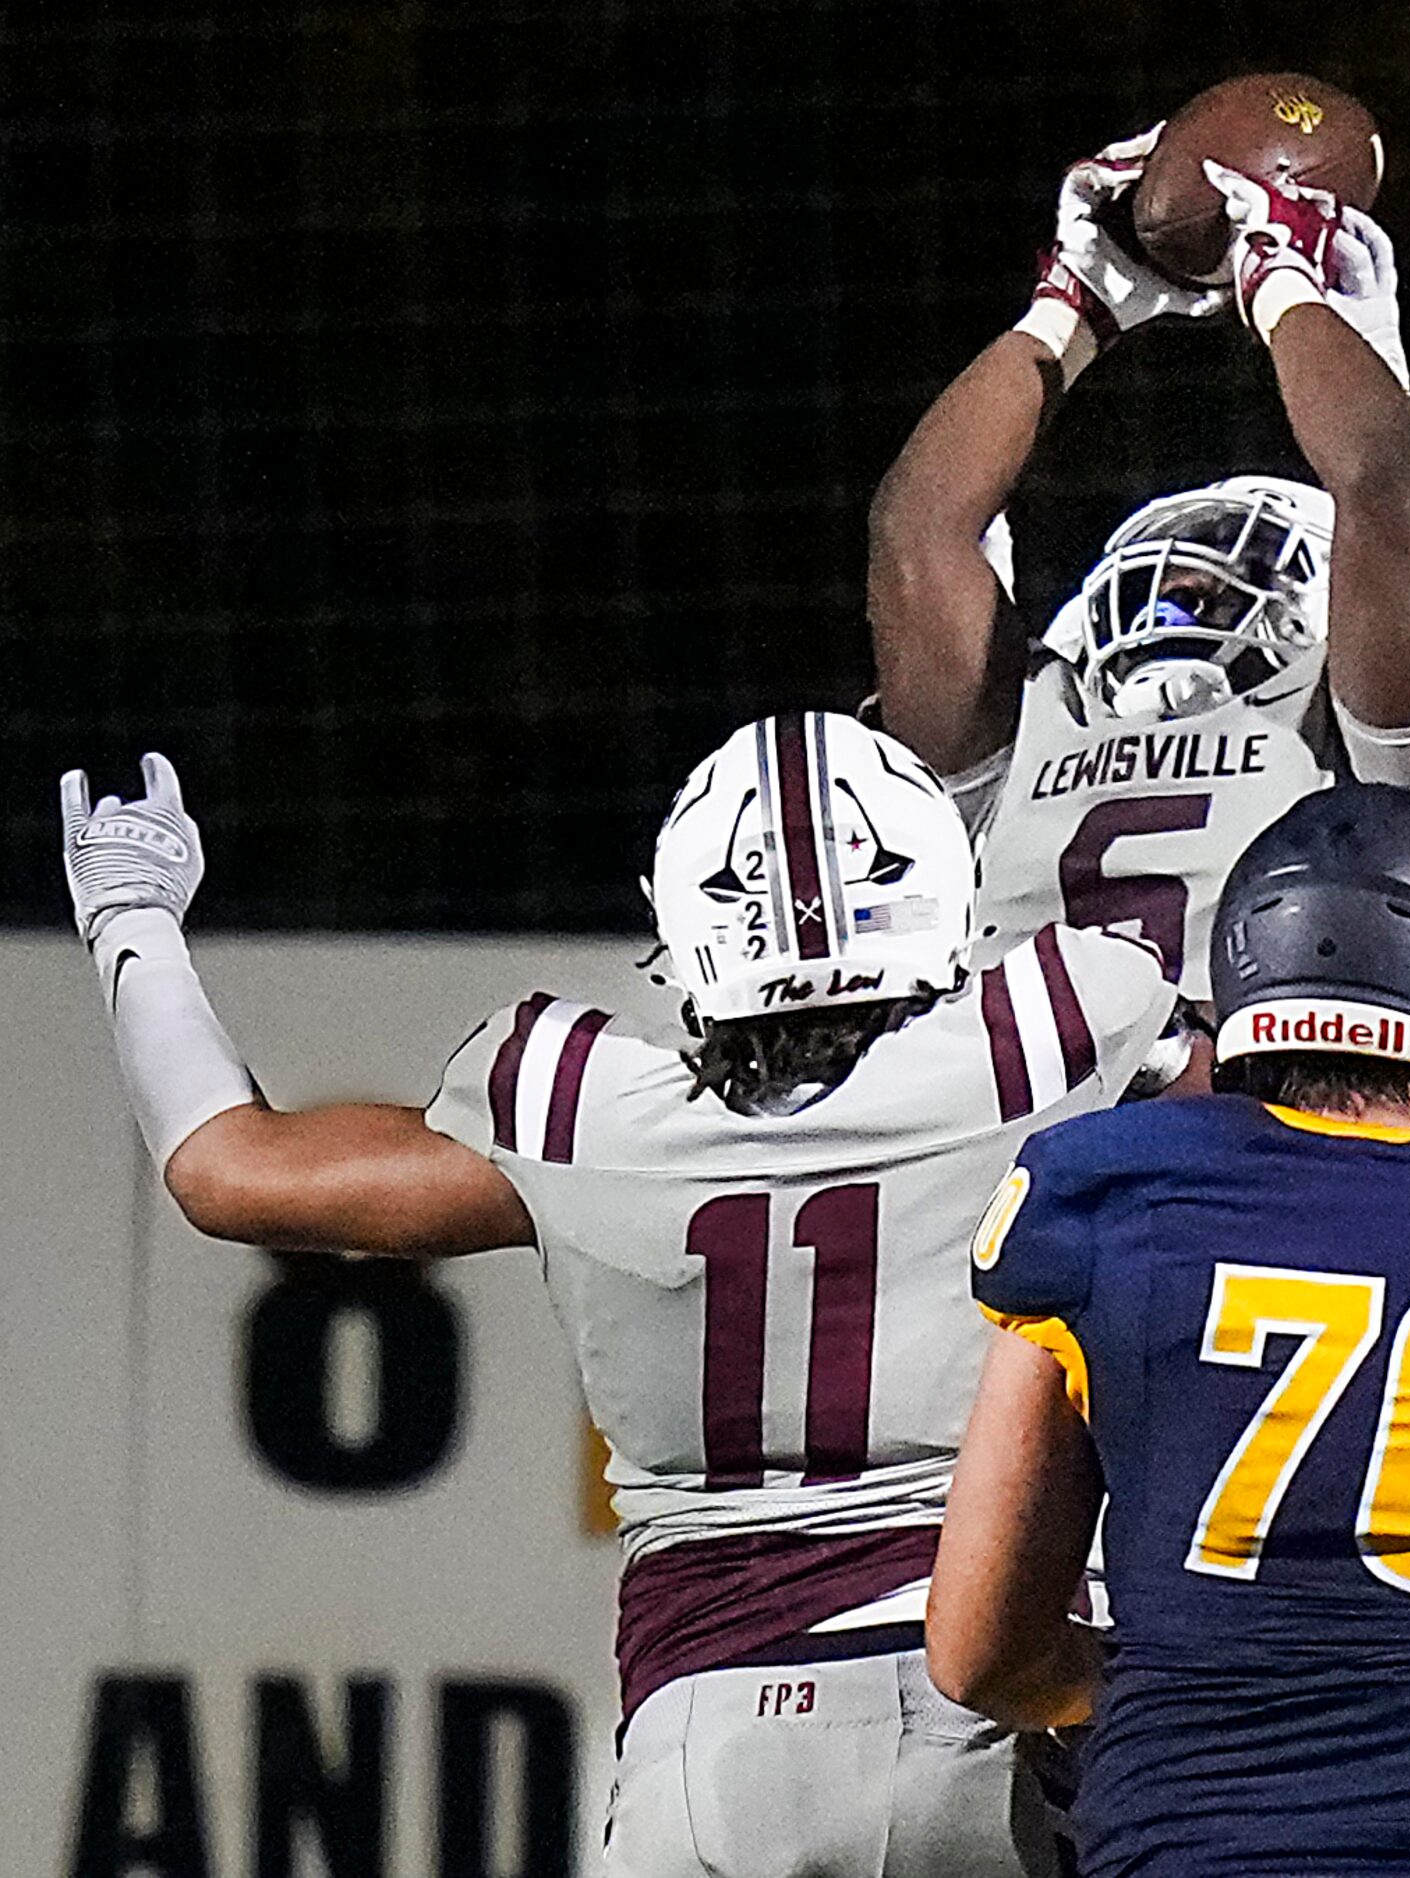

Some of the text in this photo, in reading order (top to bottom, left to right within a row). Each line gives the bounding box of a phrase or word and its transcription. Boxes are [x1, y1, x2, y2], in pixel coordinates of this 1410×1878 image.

[1031, 734, 1269, 801] LEWISVILLE
[758, 974, 816, 1008] The
[1252, 1011, 1406, 1054] Riddell
[684, 1181, 881, 1491] 11
[757, 1681, 815, 1717] FP3
[62, 1670, 584, 1878] AND
